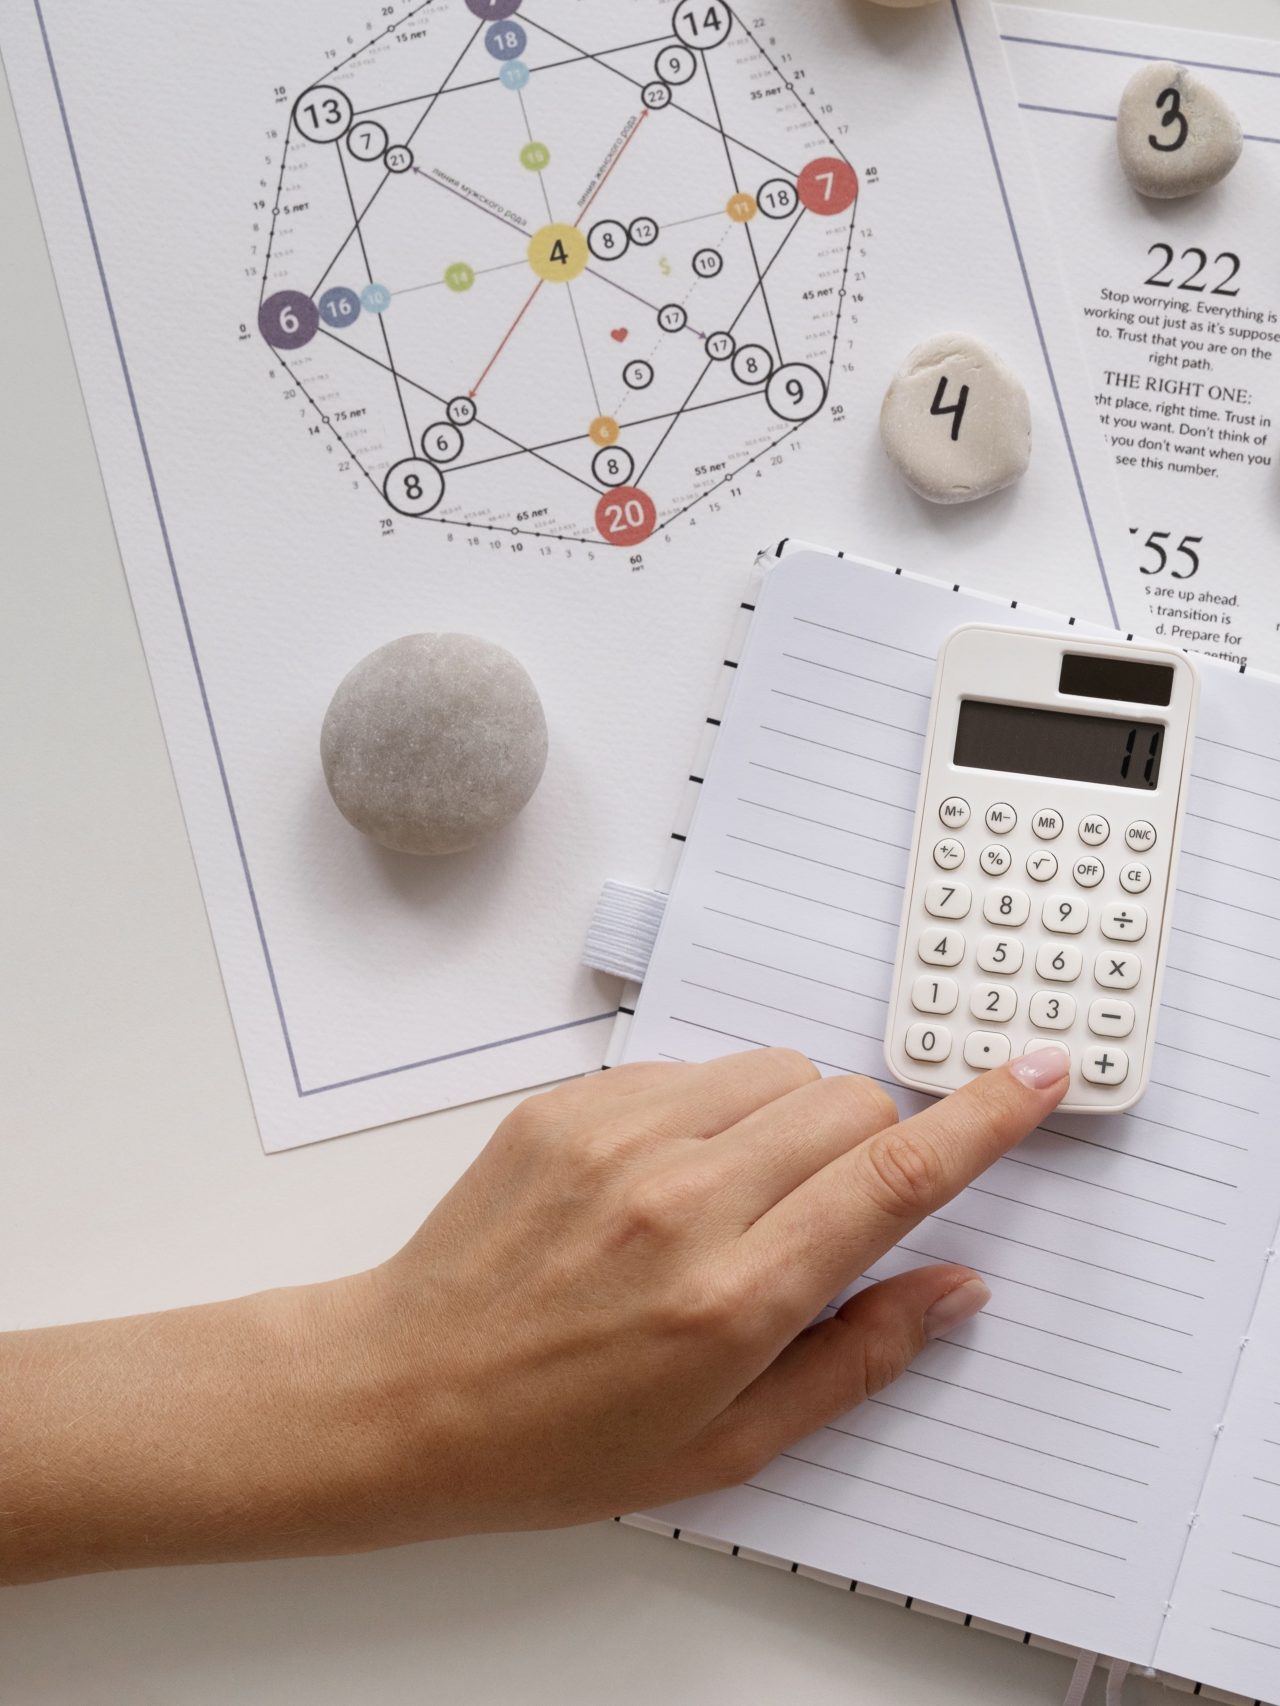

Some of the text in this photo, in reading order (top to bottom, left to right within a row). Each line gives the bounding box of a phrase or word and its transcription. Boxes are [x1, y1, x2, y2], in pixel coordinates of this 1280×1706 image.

[682, 6, 722, 36] 14
[494, 31, 518, 50] 18
[669, 57, 681, 74] 9
[648, 89, 664, 103] 22
[304, 99, 341, 129] 13
[1148, 88, 1188, 152] 3
[360, 133, 371, 150] 7
[390, 154, 405, 166] 21
[815, 171, 834, 201] 7
[766, 190, 790, 209] 18
[603, 232, 614, 248] 8
[636, 225, 651, 238] 12
[550, 239, 568, 264] 4
[700, 257, 715, 270] 10
[1143, 242, 1241, 297] 222
[327, 298, 351, 318] 16
[1100, 288, 1264, 324] Stop worrying. Everything
[279, 306, 299, 333] 6
[665, 313, 680, 325] 17
[1084, 306, 1135, 325] working
[1162, 316, 1187, 330] just
[712, 340, 728, 352] 17
[1117, 328, 1177, 348] Trust that
[746, 357, 758, 373] 8
[1149, 353, 1213, 371] right path.
[634, 369, 643, 380] 5
[785, 378, 804, 406] 9
[1104, 370, 1252, 405] THE RIGHT ONE:
[335, 412, 348, 422] 75
[454, 405, 469, 418] 16
[930, 376, 970, 441] 4
[1156, 402, 1256, 426] right time. Trust
[437, 435, 448, 451] 6
[1218, 428, 1250, 444] think
[1174, 444, 1205, 458] want
[1209, 447, 1244, 462] when
[607, 459, 619, 474] 8
[694, 465, 708, 476] 55
[1141, 456, 1219, 478] this number.
[404, 474, 423, 500] 8
[605, 499, 644, 533] 20
[1198, 592, 1240, 607] ahead.
[1157, 604, 1218, 624] transition
[1171, 625, 1221, 642] Prepare
[945, 806, 965, 817] M+
[1038, 817, 1056, 829] MR
[1084, 823, 1103, 835] MC
[1129, 829, 1151, 841] ON/C
[1077, 864, 1099, 876] OFF
[1127, 870, 1142, 882] CE
[940, 887, 956, 907] 7
[1000, 895, 1013, 915] 8
[1059, 903, 1072, 922] 9
[934, 936, 948, 955] 4
[992, 943, 1008, 962] 5
[1052, 950, 1065, 970] 6
[932, 983, 939, 1003] 1
[986, 991, 1000, 1012] 2
[1046, 999, 1059, 1019] 3
[921, 1031, 935, 1051] 0
